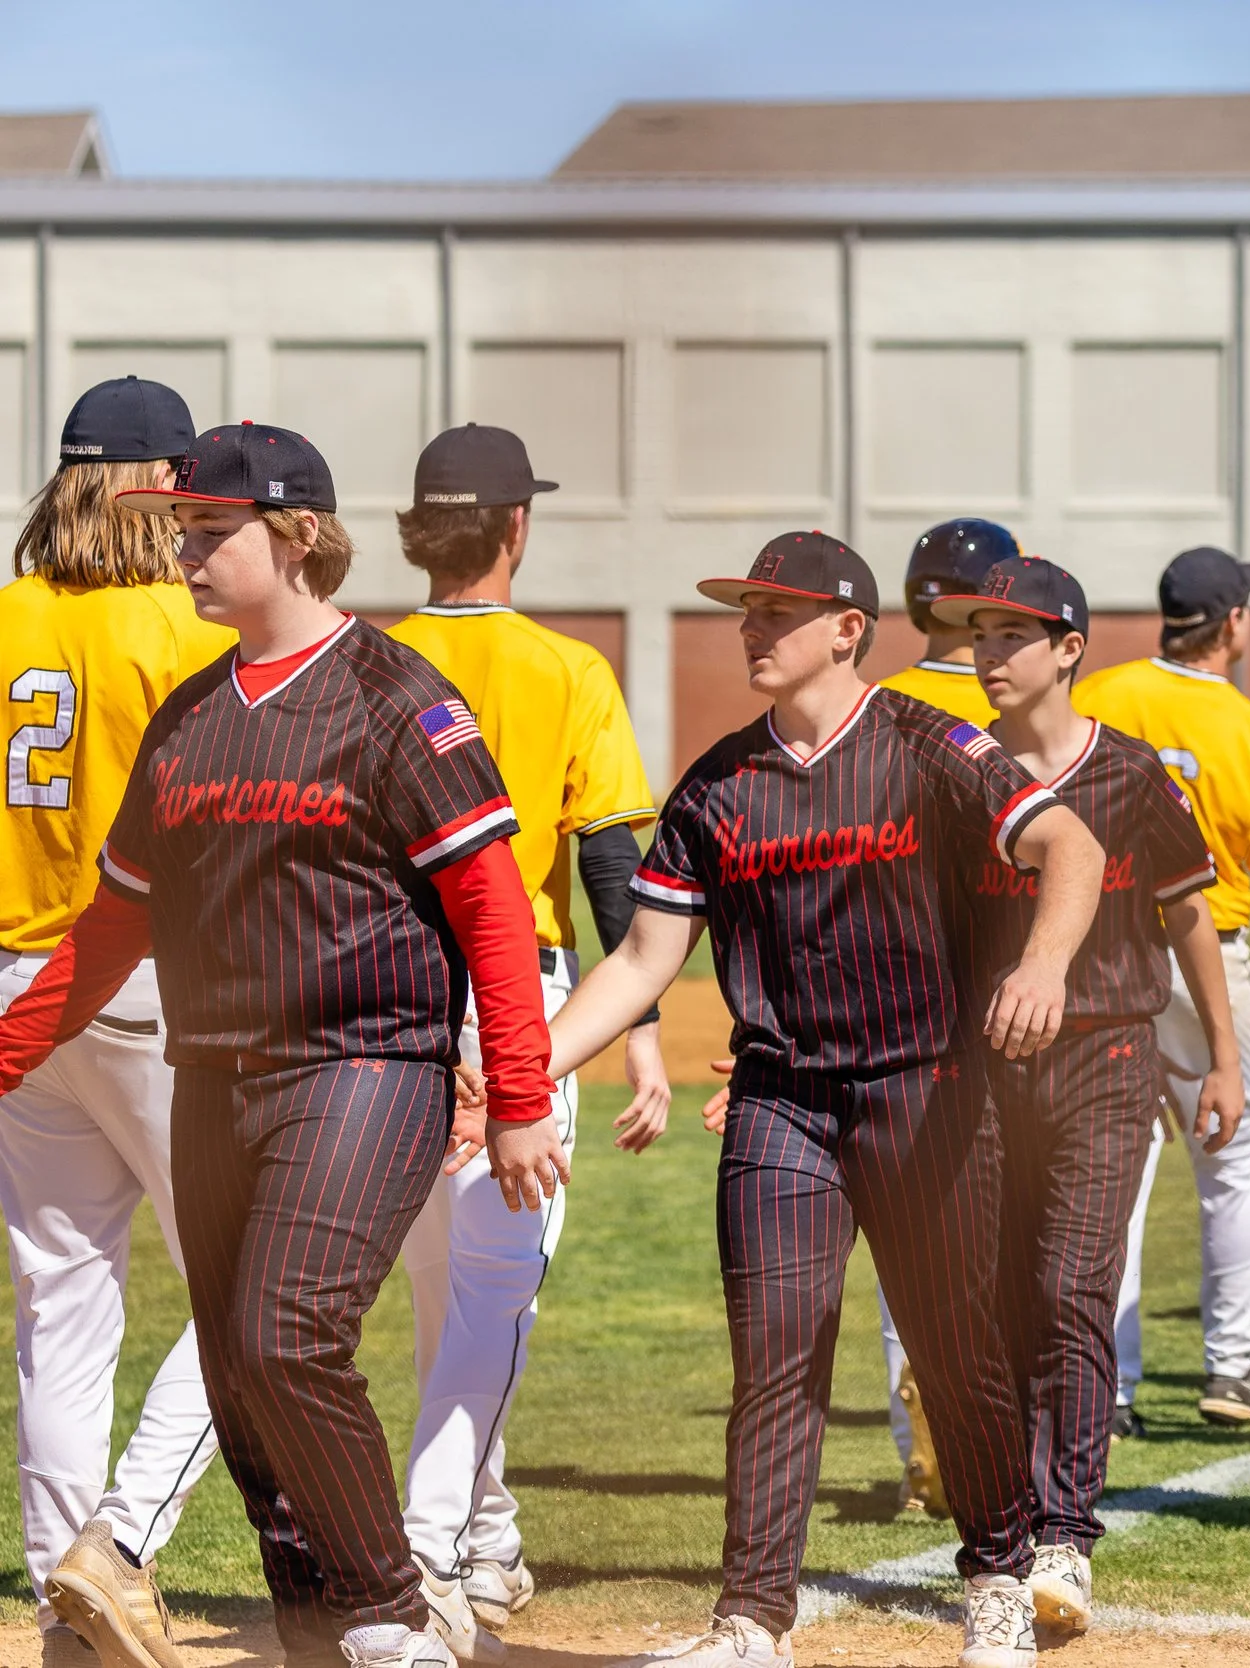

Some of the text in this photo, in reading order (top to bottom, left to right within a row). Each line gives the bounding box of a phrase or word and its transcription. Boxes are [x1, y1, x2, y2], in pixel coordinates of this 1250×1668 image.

[6, 667, 77, 810] 2
[153, 755, 348, 835] Hurricanes
[714, 813, 920, 888] Hurricanes
